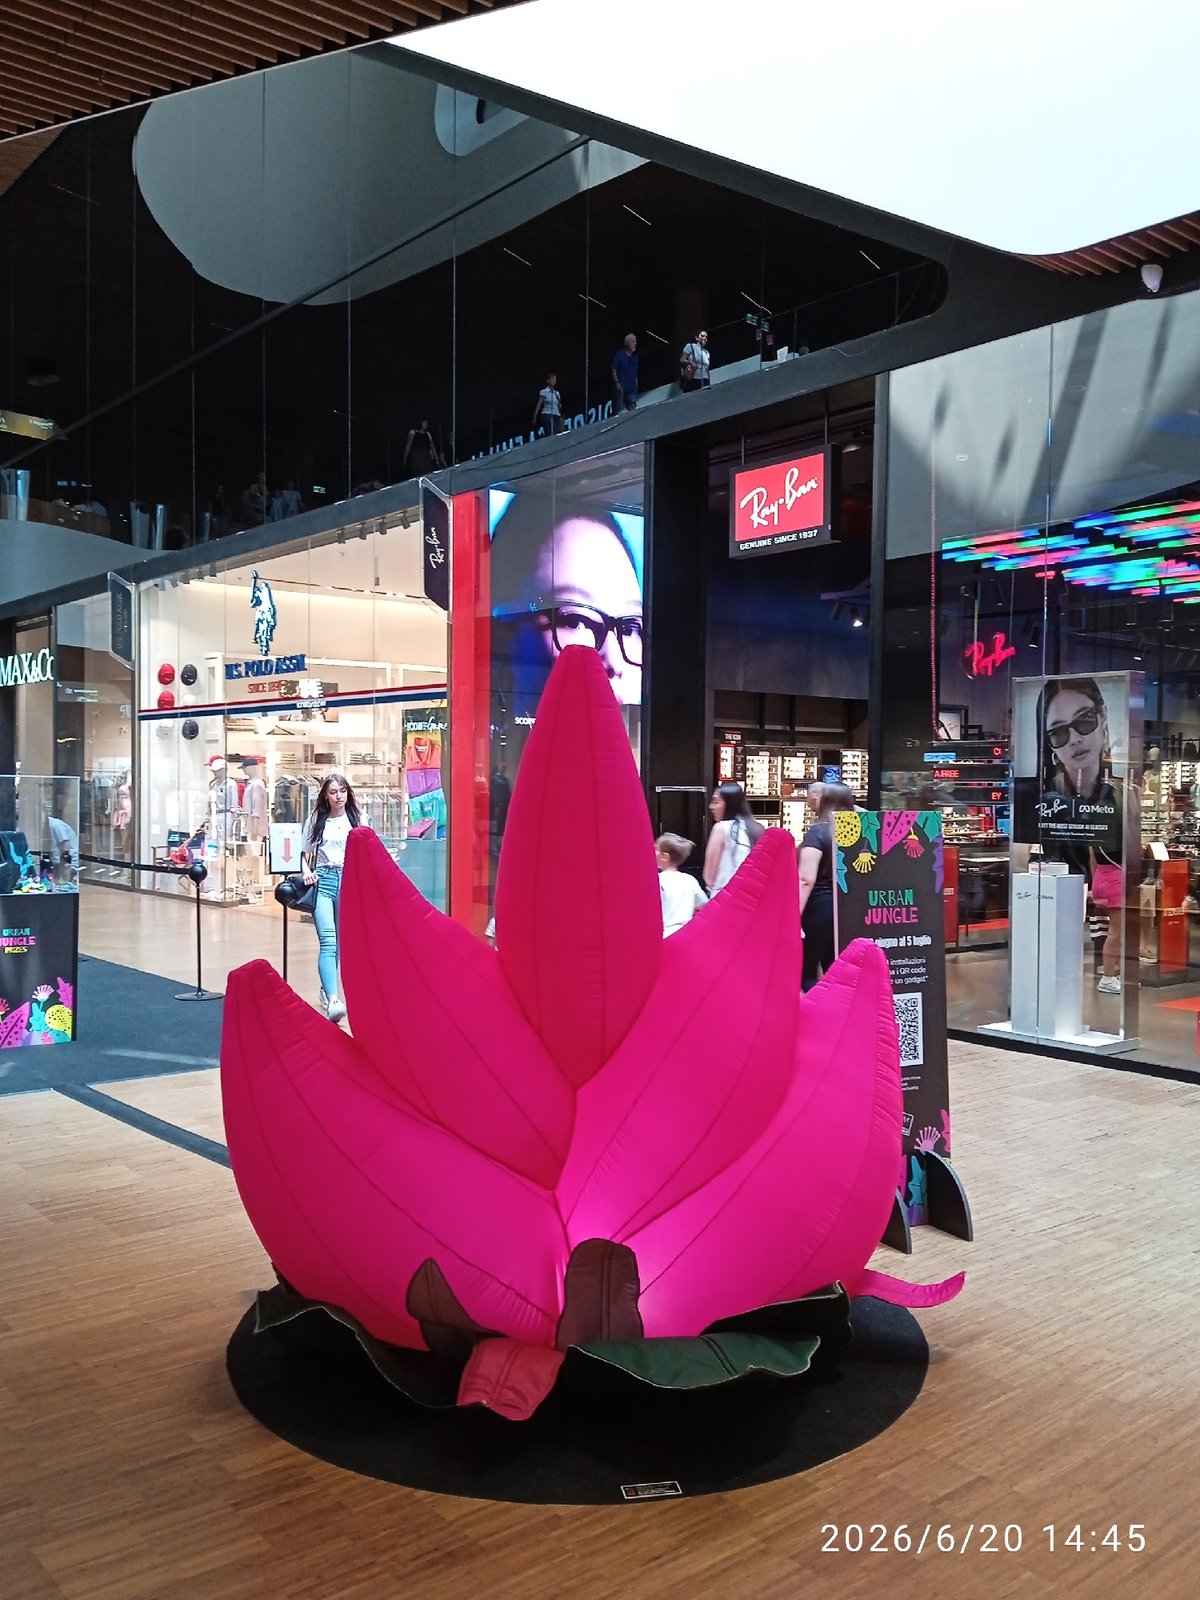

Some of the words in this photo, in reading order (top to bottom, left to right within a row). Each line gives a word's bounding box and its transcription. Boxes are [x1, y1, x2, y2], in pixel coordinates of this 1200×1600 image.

[740, 538, 772, 550] GENUINE
[774, 533, 798, 545] SINCE
[799, 530, 819, 540] 1937
[1091, 805, 1114, 814] Meta
[868, 889, 914, 907] URBAN
[865, 907, 918, 925] JUNGLE
[3, 928, 31, 936] URBAN
[898, 935, 906, 947] al
[907, 935, 912, 947] 5
[913, 934, 932, 947] luglio
[890, 956, 926, 966] installazioni
[900, 966, 910, 975] QR
[911, 965, 926, 973] code
